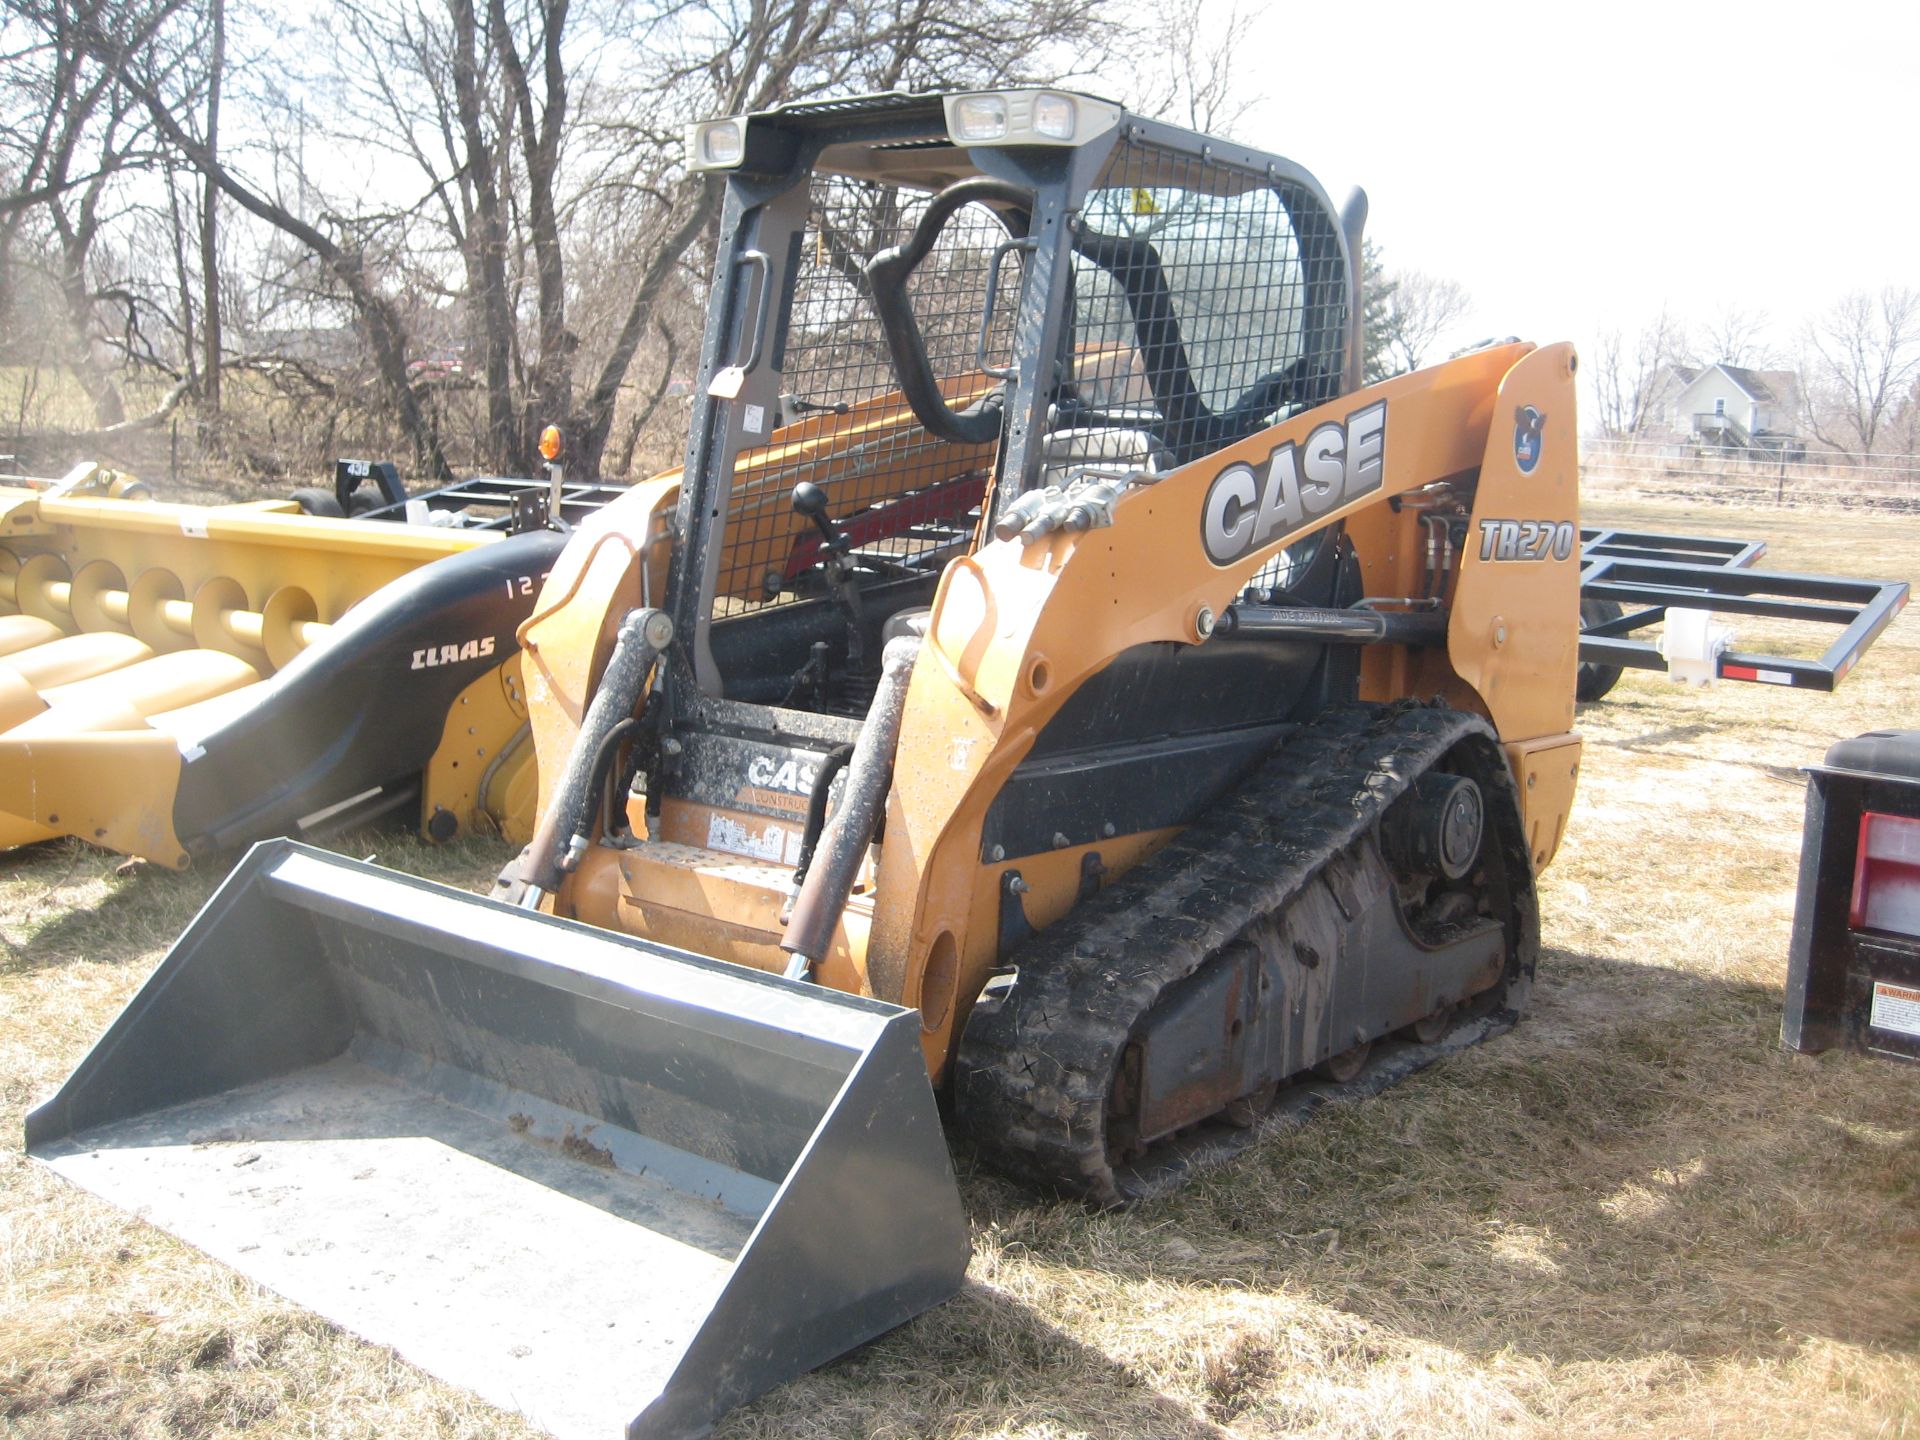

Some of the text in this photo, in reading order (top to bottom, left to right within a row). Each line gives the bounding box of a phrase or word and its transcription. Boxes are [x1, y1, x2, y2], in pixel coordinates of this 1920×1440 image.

[1203, 399, 1387, 564] CASE
[1479, 519, 1574, 561] TR270
[506, 572, 549, 599] 12
[411, 636, 495, 670] CLAAS
[748, 756, 840, 798] CAS
